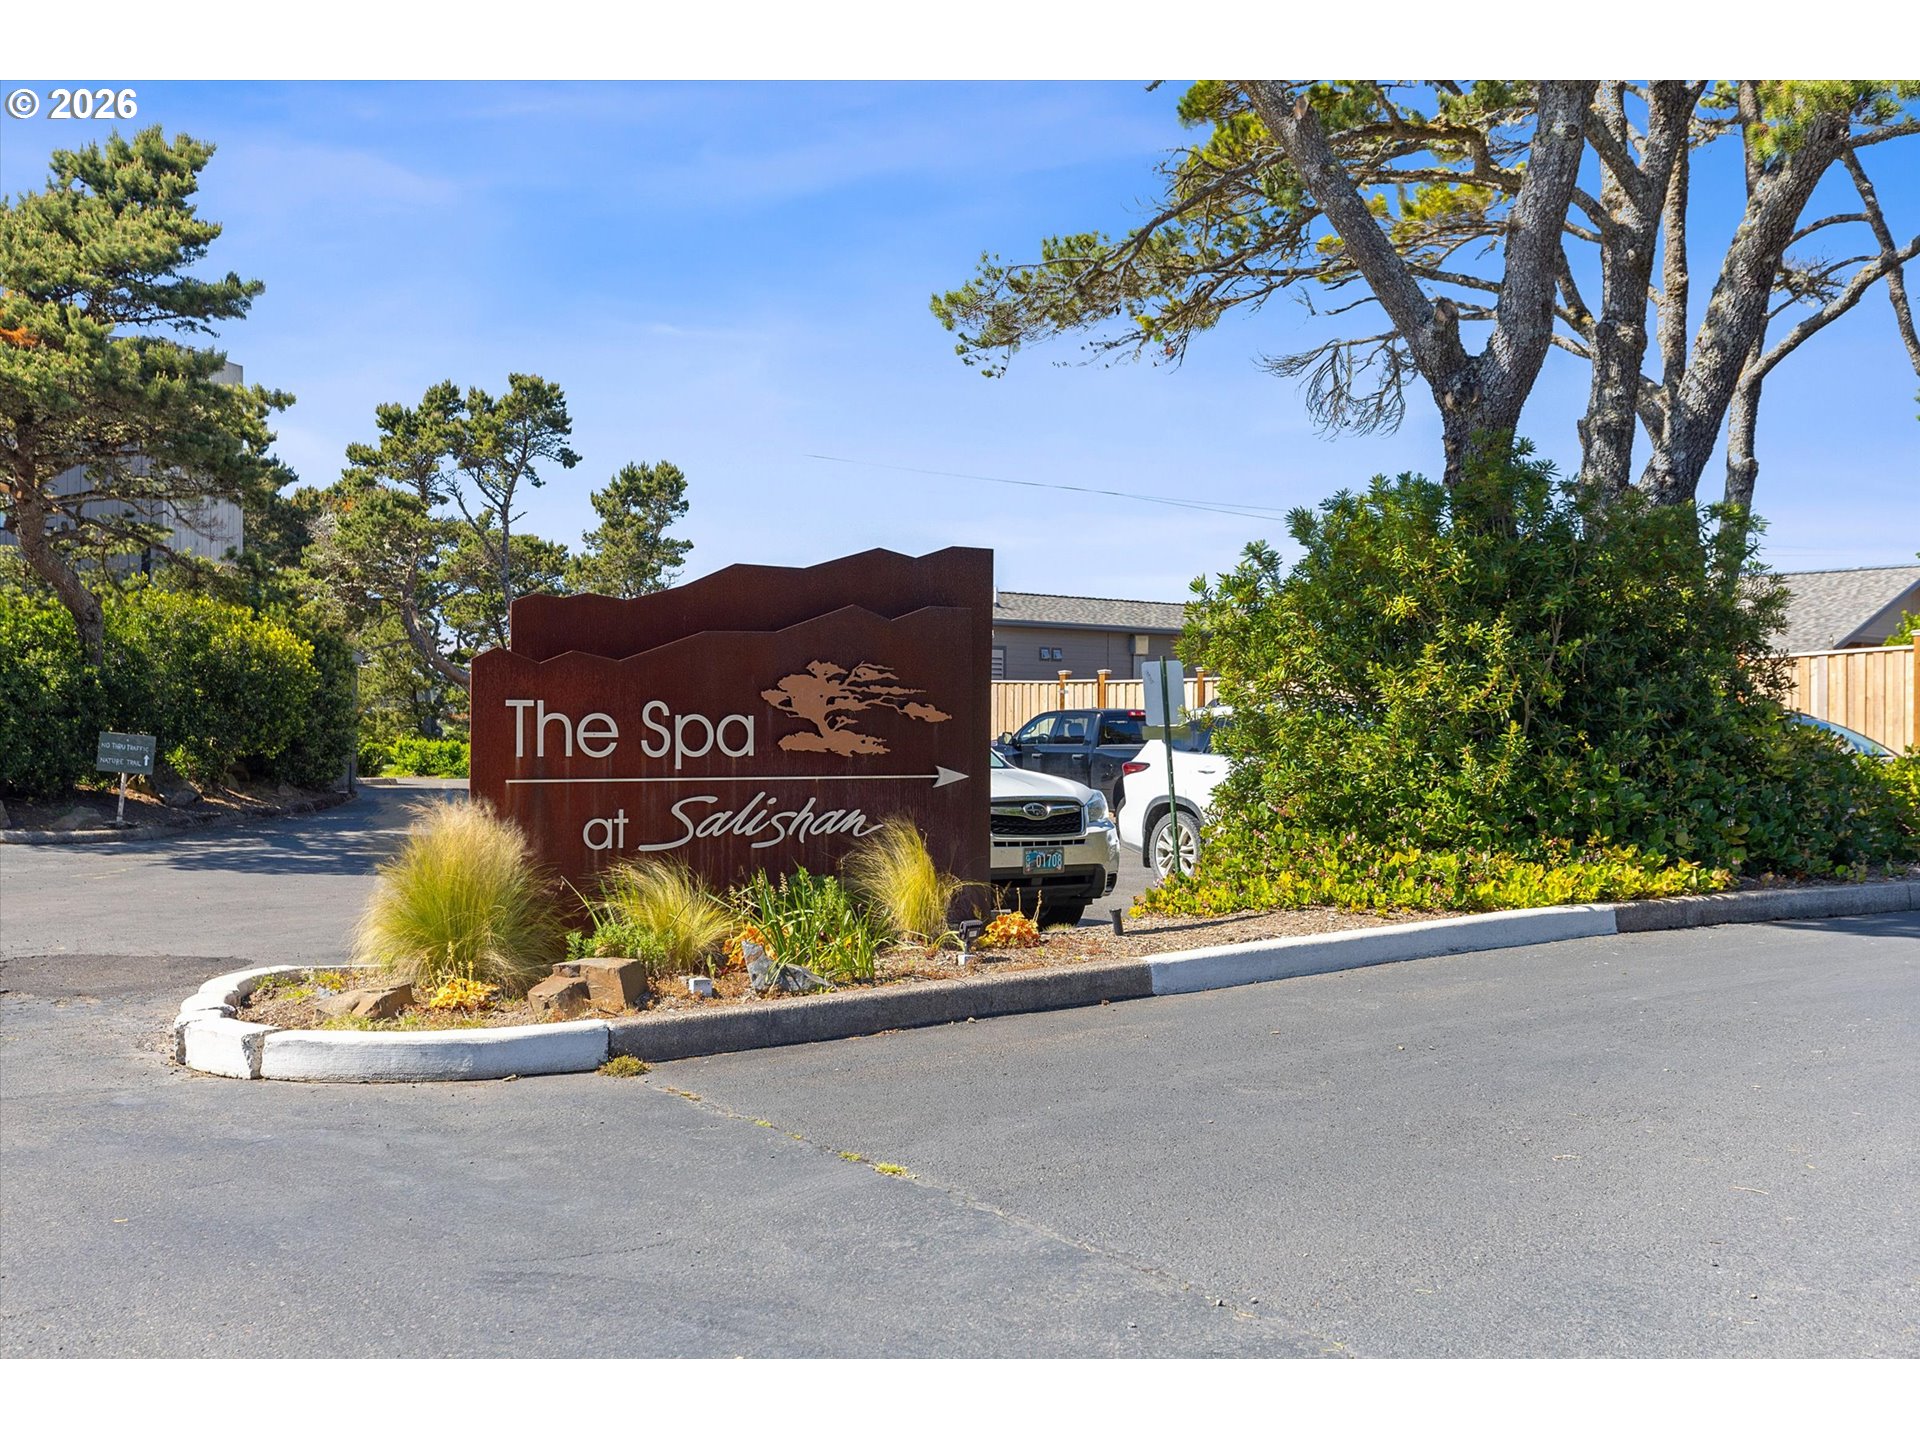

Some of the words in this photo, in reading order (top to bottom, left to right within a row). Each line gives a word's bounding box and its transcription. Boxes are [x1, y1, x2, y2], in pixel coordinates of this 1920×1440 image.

[112, 742, 126, 750] THRU
[127, 743, 149, 753] TRAFFIC
[506, 699, 619, 758] The
[640, 700, 755, 770] Spa
[100, 757, 124, 766] NATURE
[126, 758, 142, 767] TRAIL
[583, 808, 629, 850] at
[638, 792, 884, 852] Salishan
